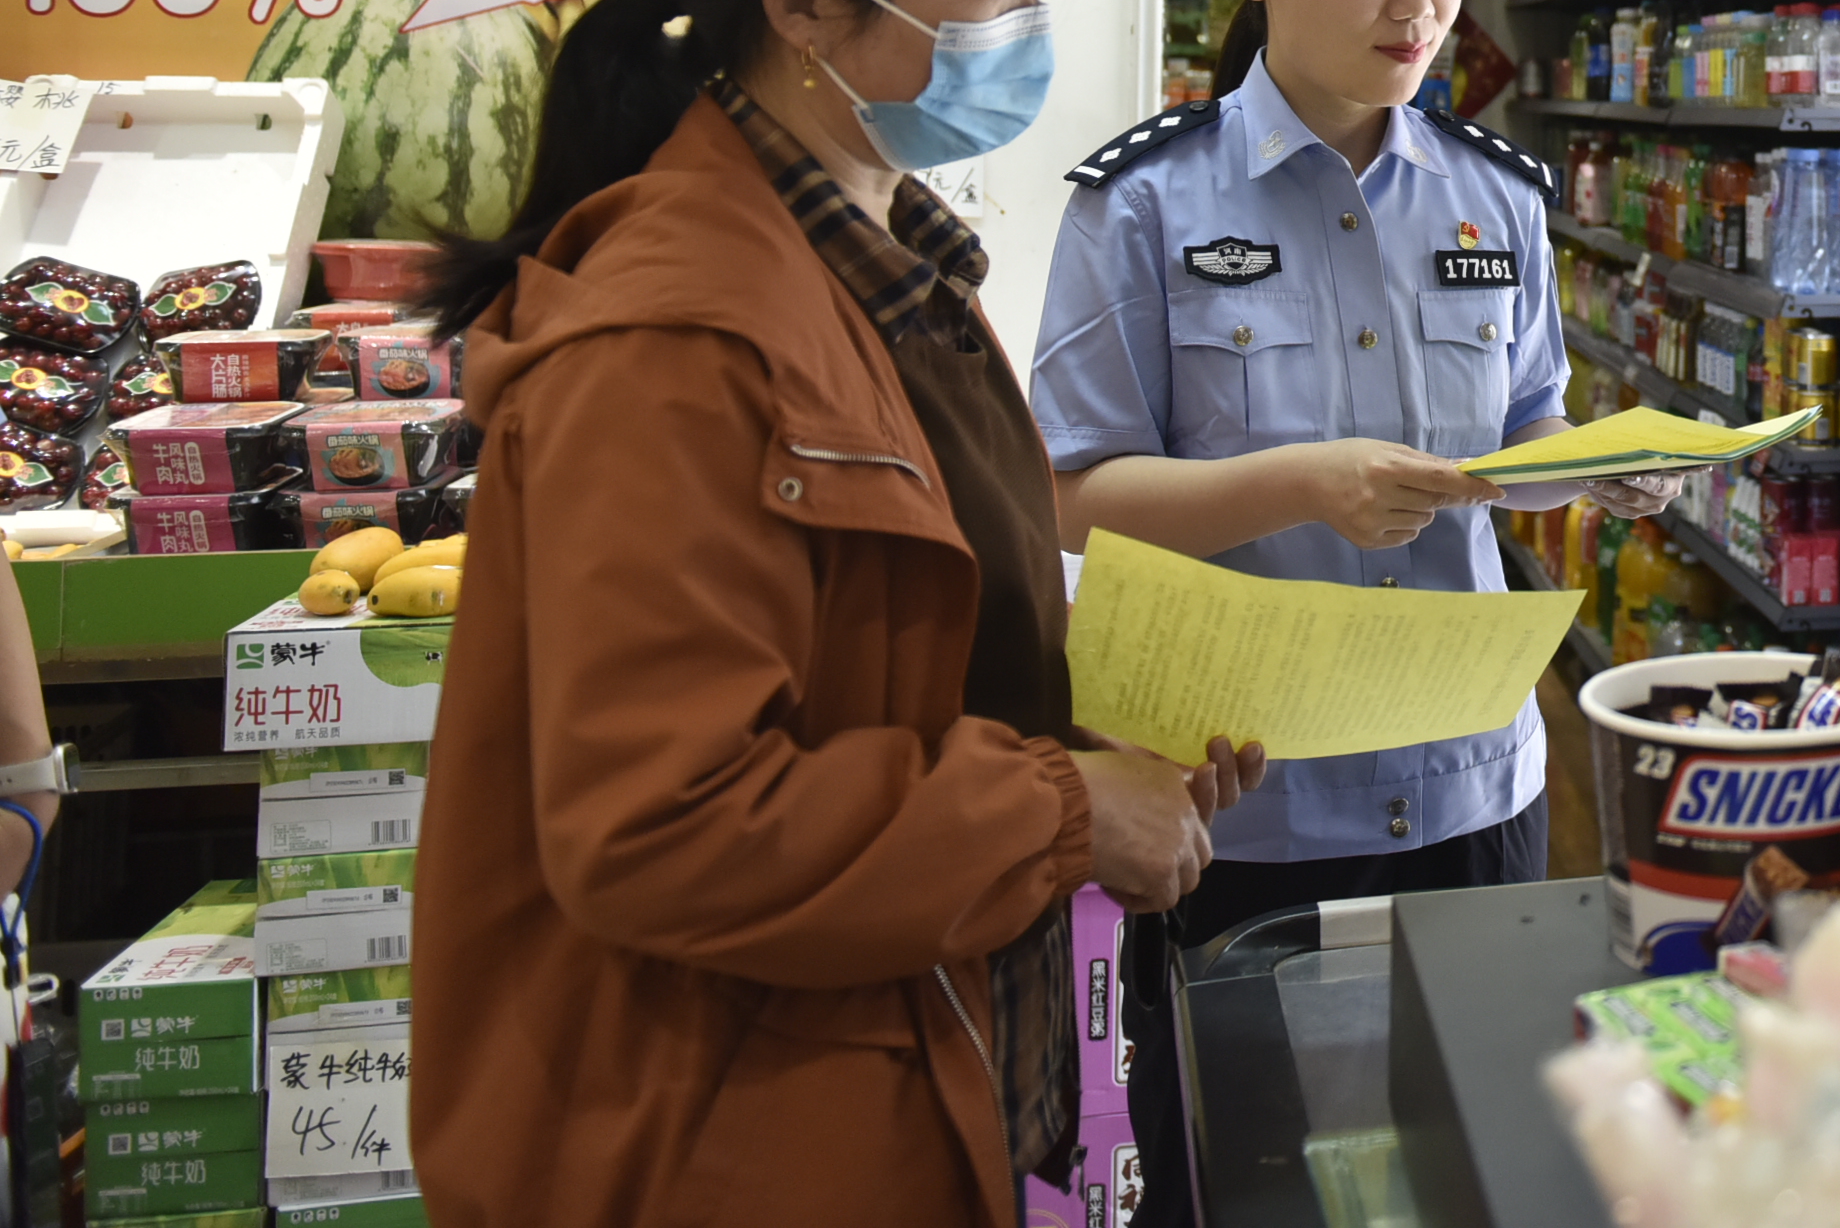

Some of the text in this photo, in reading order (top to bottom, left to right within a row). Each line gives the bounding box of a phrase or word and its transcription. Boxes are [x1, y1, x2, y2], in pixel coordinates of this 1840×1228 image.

[1445, 258, 1513, 280] 177161
[227, 354, 242, 398] 自热火锅
[152, 443, 174, 485] 牛肉
[169, 443, 189, 485] 风味丸
[157, 512, 178, 554] 牛肉
[174, 511, 195, 553] 风味丸
[270, 641, 325, 667] 蒙牛
[234, 683, 342, 727] 纯牛奶
[233, 726, 341, 742] 浓纯营养 航天品质
[1634, 745, 1677, 781] 23
[135, 1044, 200, 1072] 纯牛奶
[141, 1159, 206, 1187] 纯牛奶
